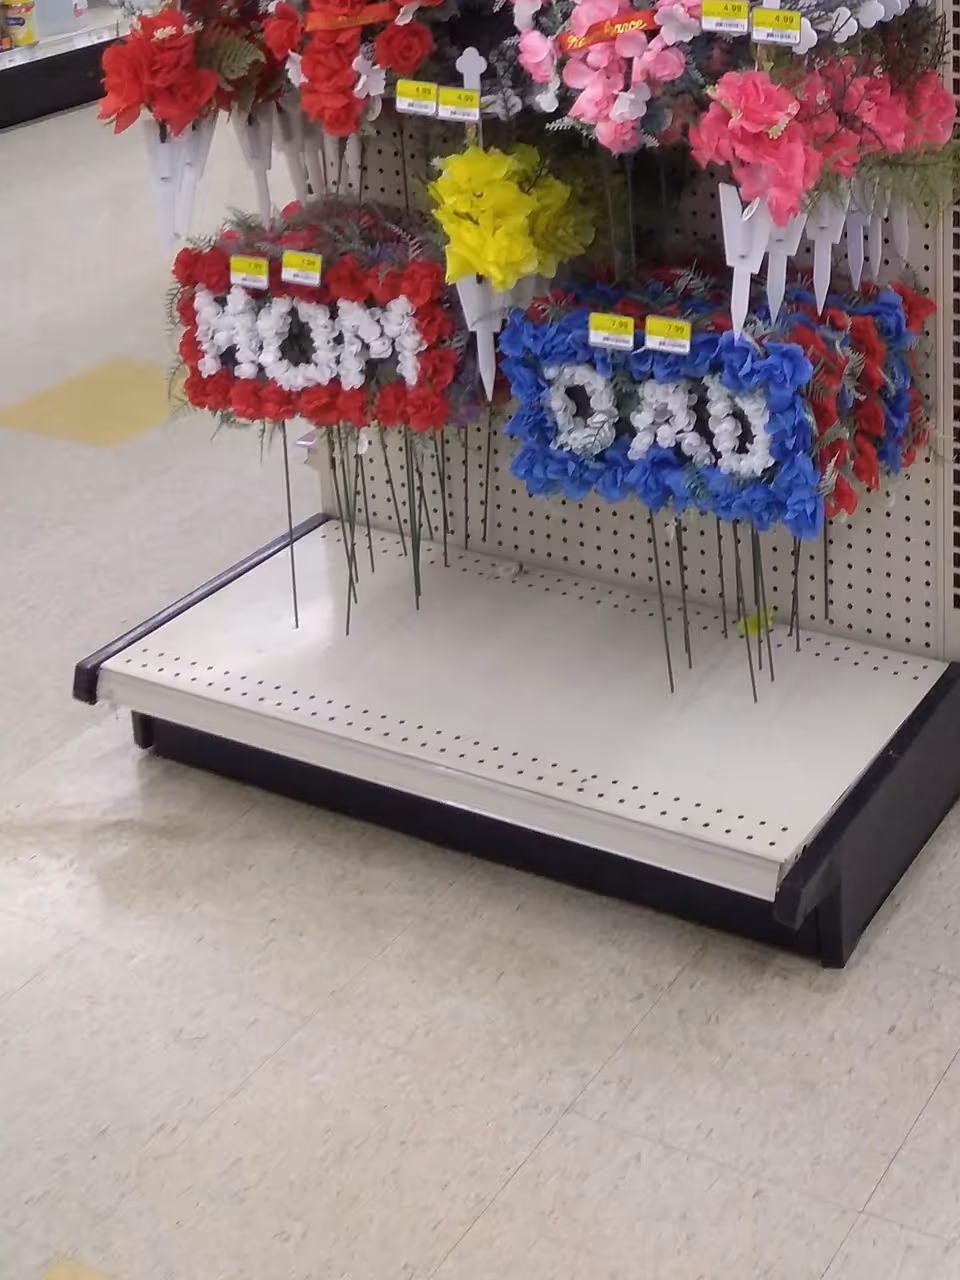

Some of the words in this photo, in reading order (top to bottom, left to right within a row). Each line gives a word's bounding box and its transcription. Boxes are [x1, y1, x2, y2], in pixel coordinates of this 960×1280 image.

[723, 3, 742, 13] 4.99
[774, 14, 794, 24] 4.99
[667, 323, 686, 334] 7.99
[194, 283, 427, 392] MOM
[544, 363, 776, 478] DAD
